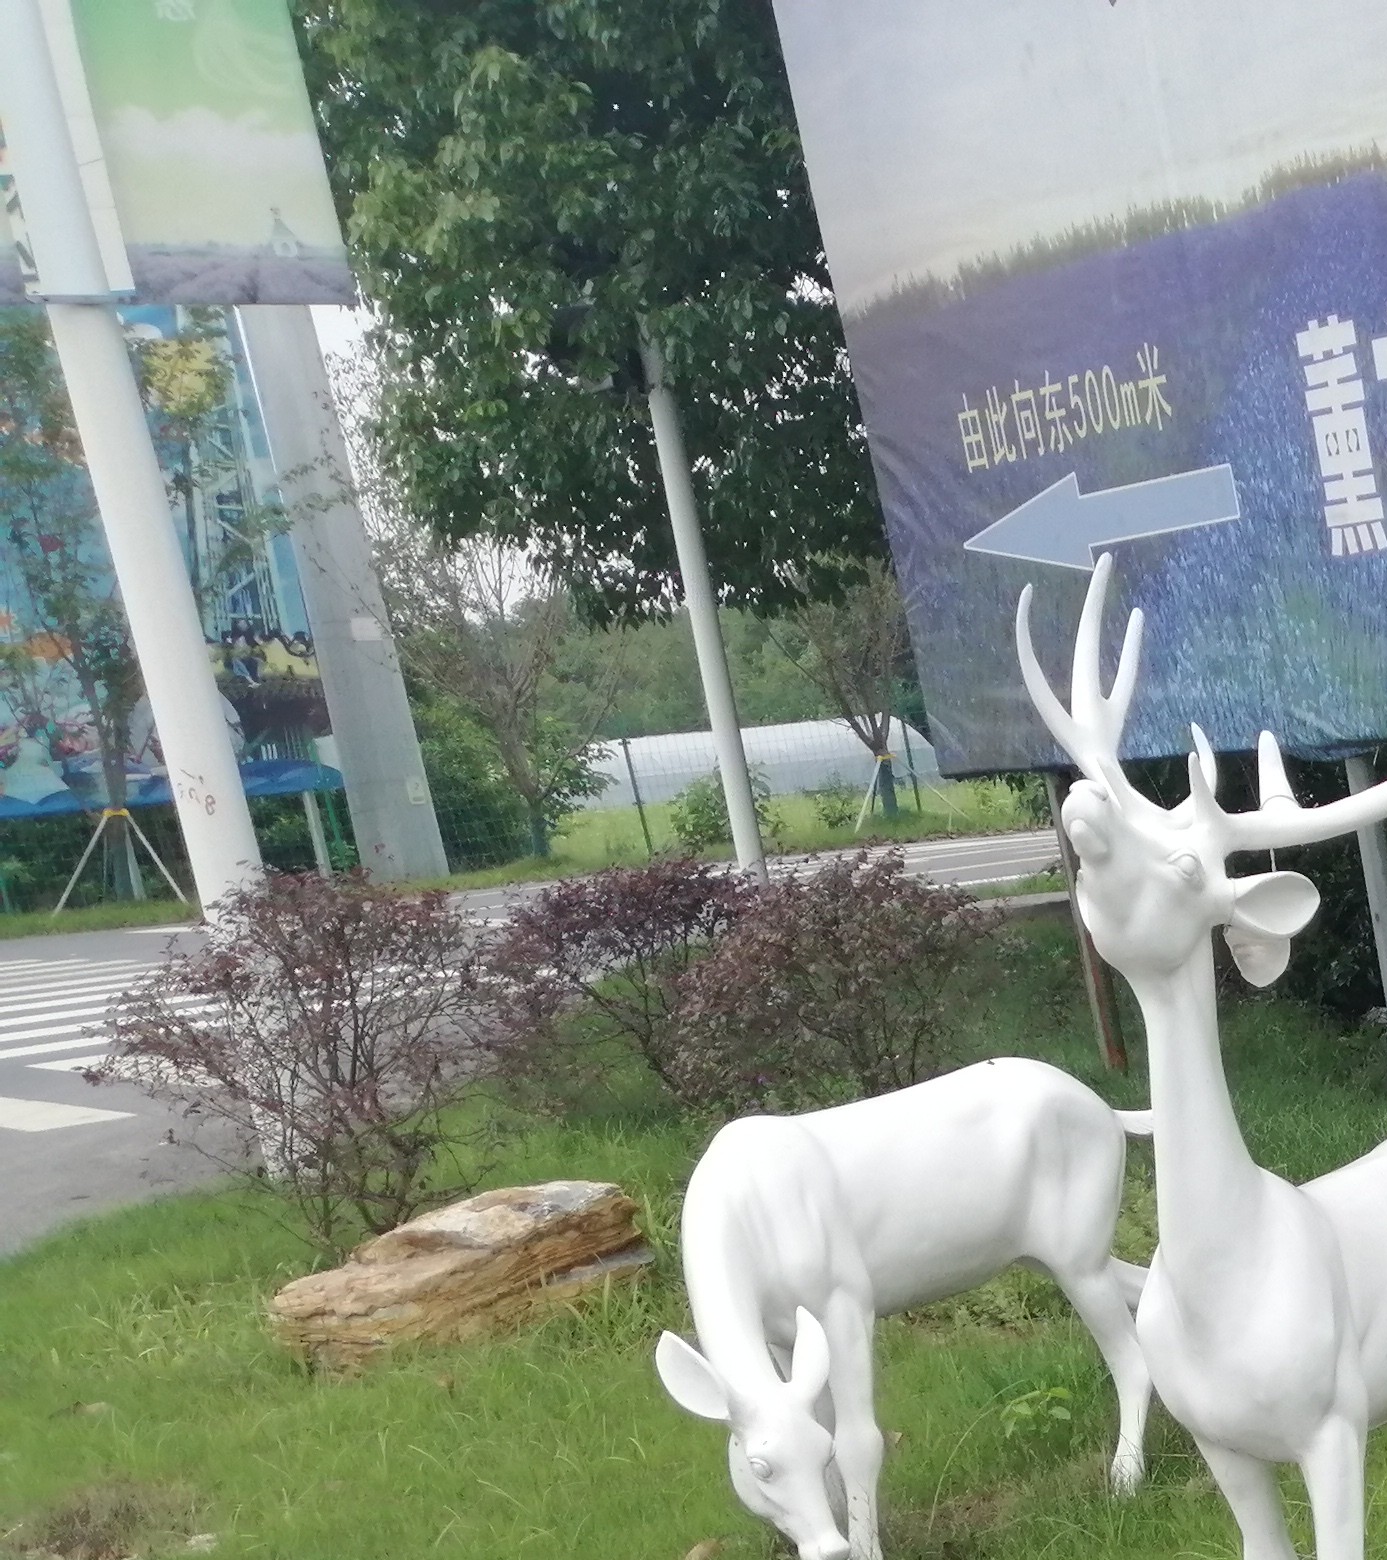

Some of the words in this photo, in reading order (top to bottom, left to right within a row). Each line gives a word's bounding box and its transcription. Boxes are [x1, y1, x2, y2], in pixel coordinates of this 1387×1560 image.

[957, 342, 1172, 474] 由此向东500m米
